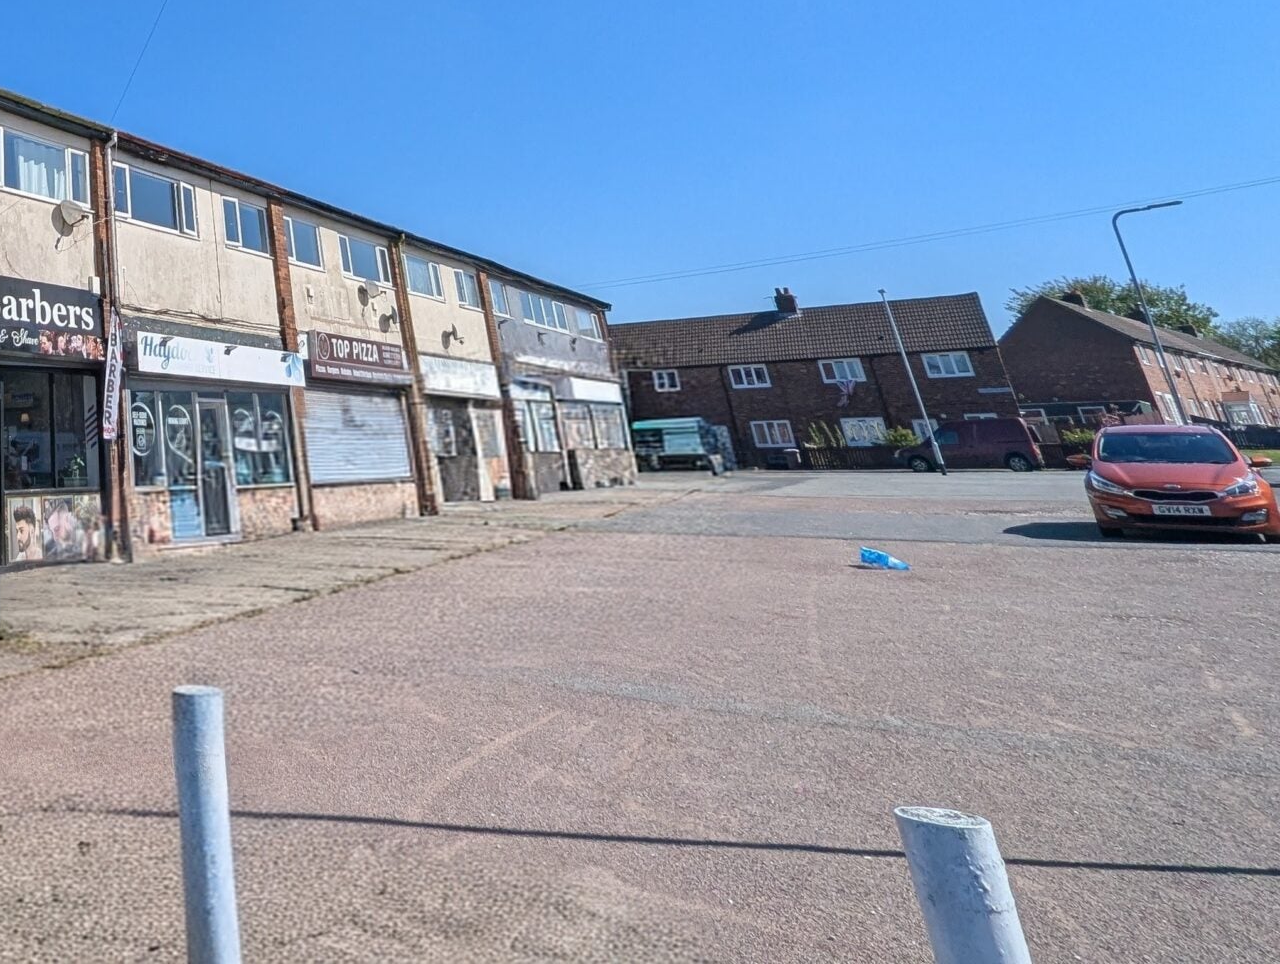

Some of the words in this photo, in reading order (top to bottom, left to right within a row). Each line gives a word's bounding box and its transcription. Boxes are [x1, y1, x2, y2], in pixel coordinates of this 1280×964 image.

[0, 329, 9, 343] &
[331, 338, 350, 359] TOP
[352, 341, 380, 363] PIZZA
[104, 332, 118, 425] BARBER
